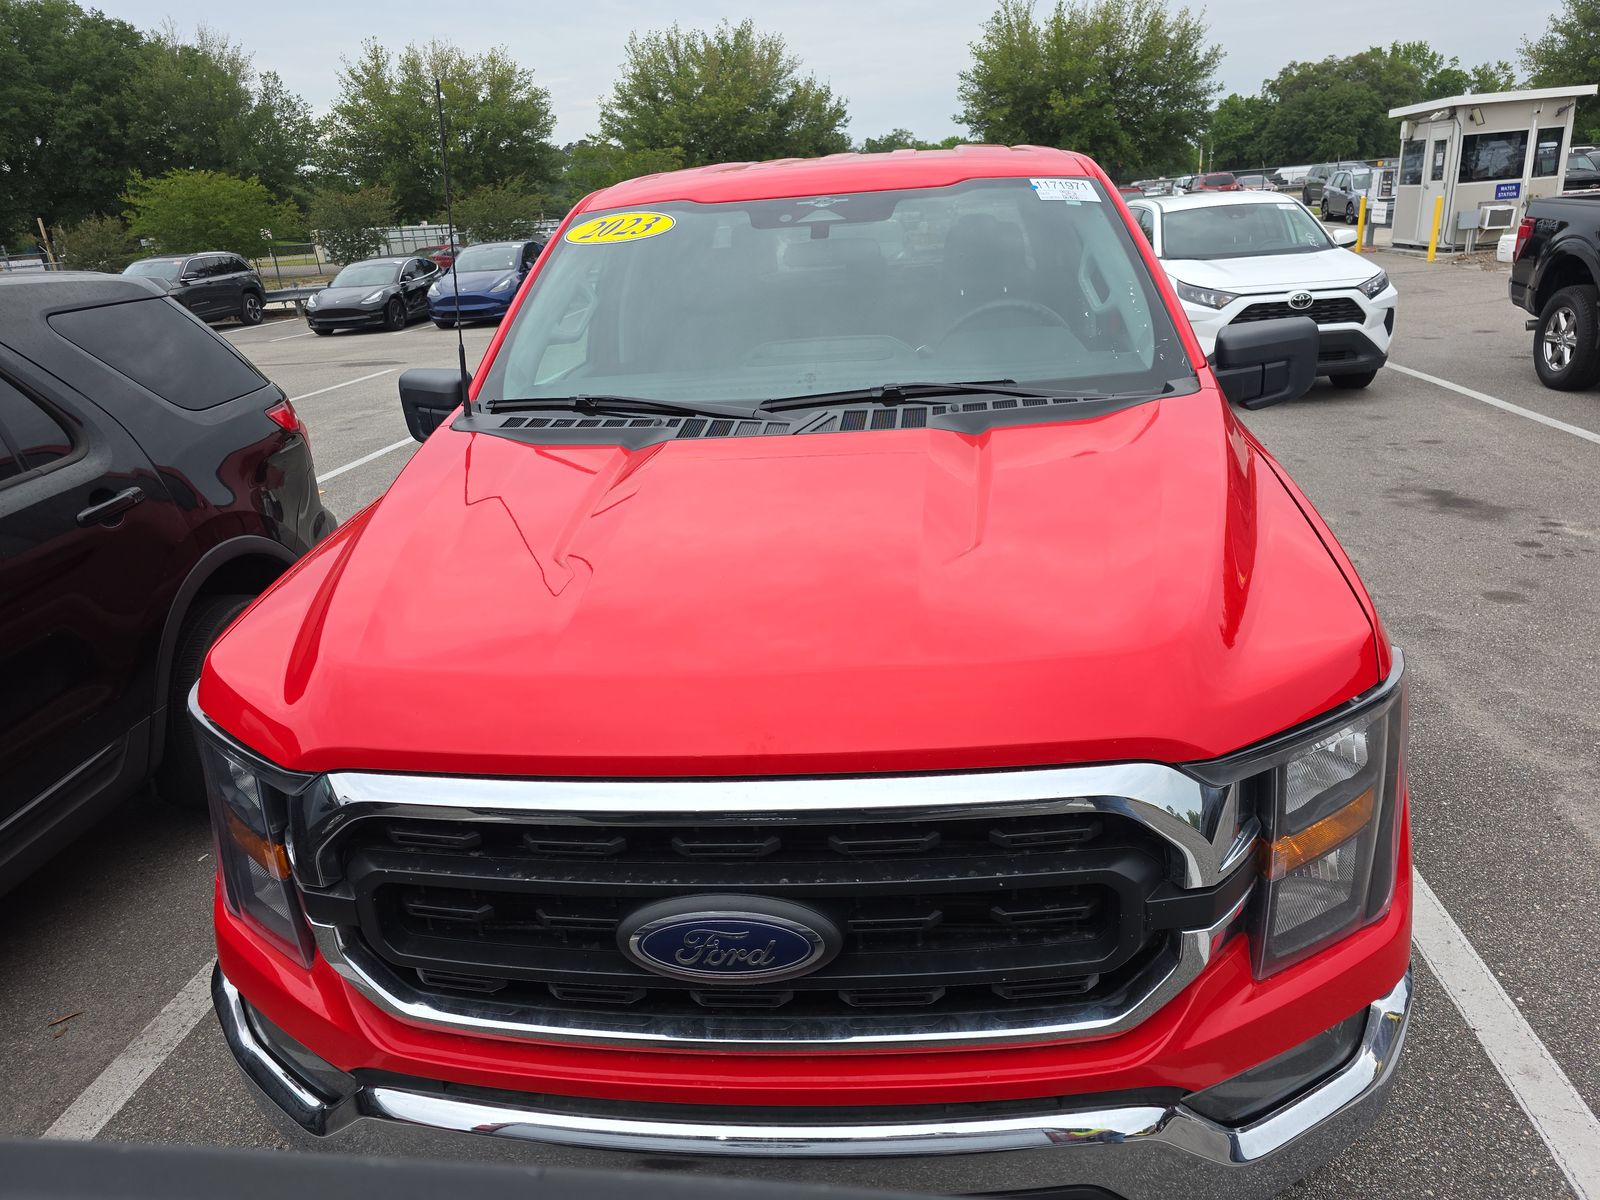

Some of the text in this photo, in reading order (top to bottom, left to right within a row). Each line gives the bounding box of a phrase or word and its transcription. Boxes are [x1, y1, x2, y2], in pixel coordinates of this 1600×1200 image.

[1035, 180, 1089, 191] 1171971
[578, 216, 662, 240] 2023
[675, 929, 776, 967] Ford
